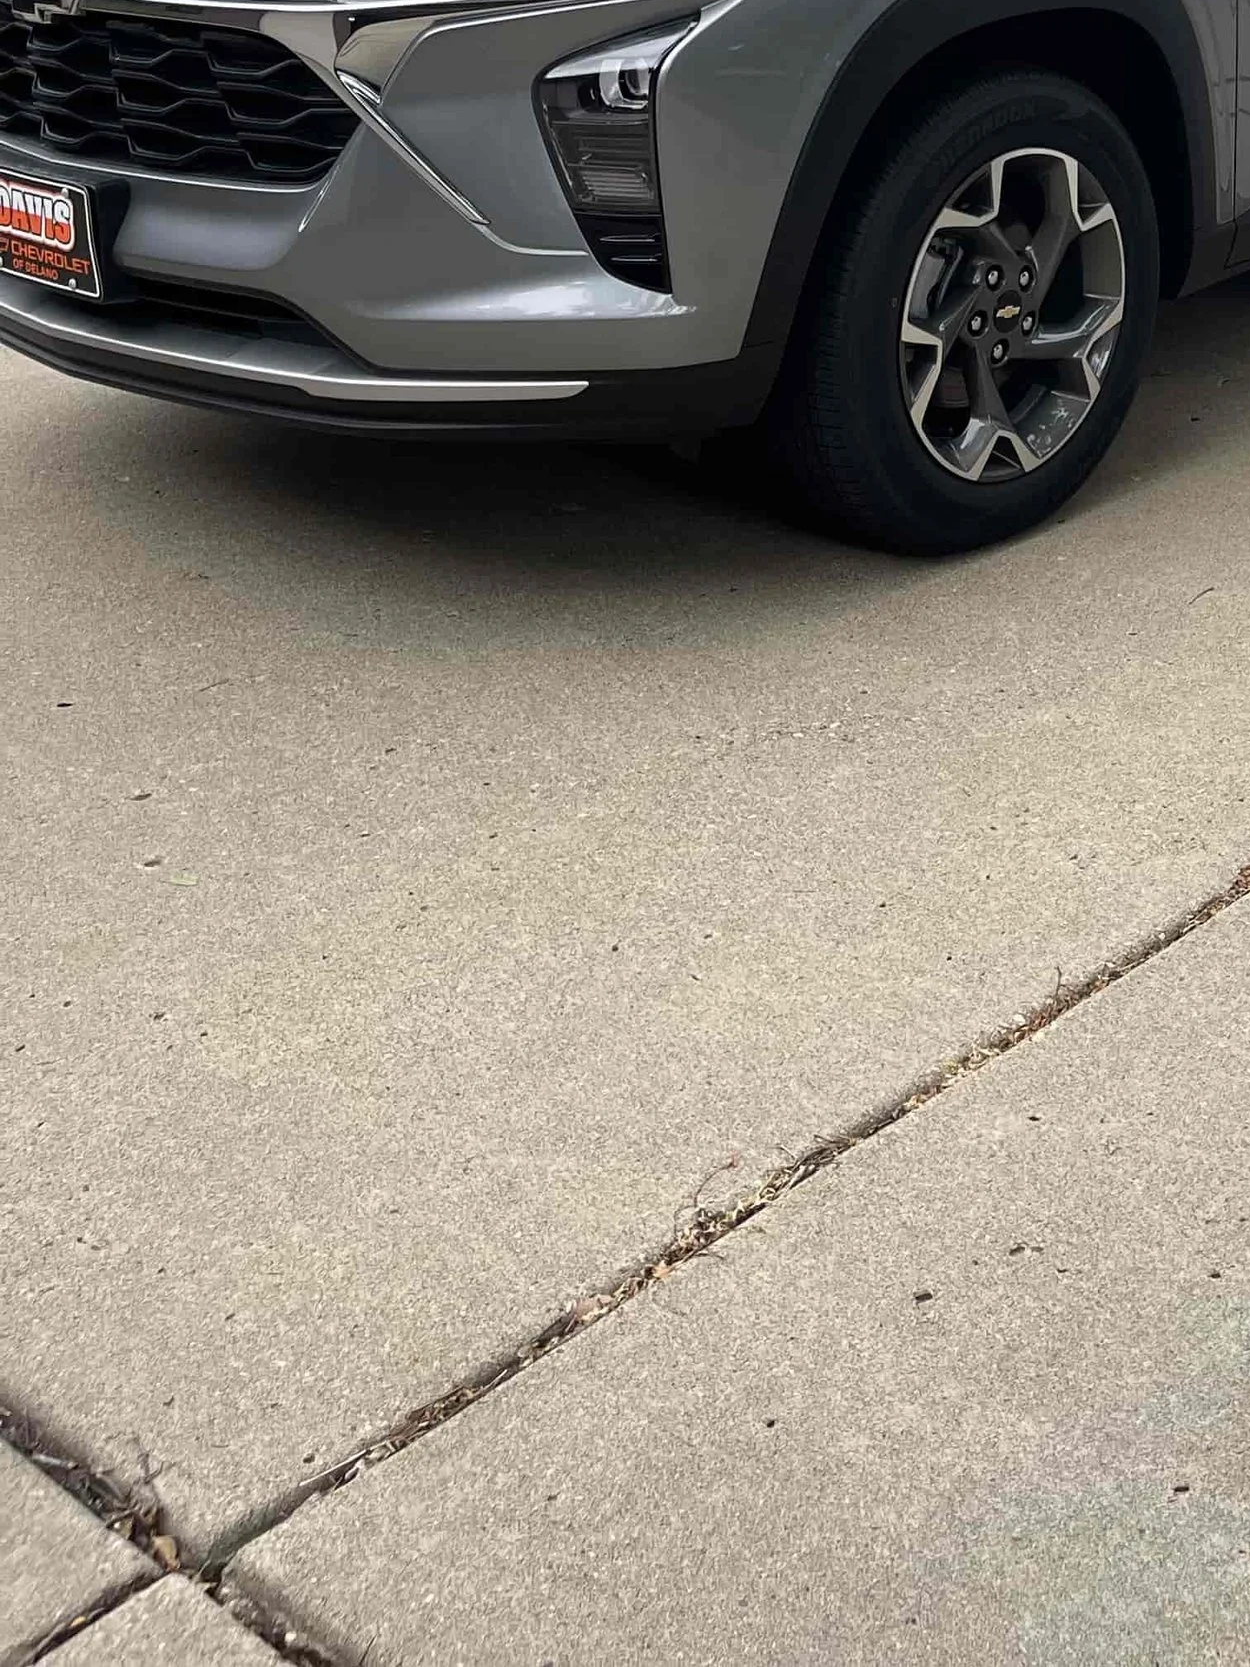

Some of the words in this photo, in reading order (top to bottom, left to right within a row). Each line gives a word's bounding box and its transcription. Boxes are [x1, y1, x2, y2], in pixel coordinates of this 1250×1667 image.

[0, 184, 72, 245] DAVIS
[11, 239, 91, 275] CHEVROLET
[13, 258, 24, 270] OF
